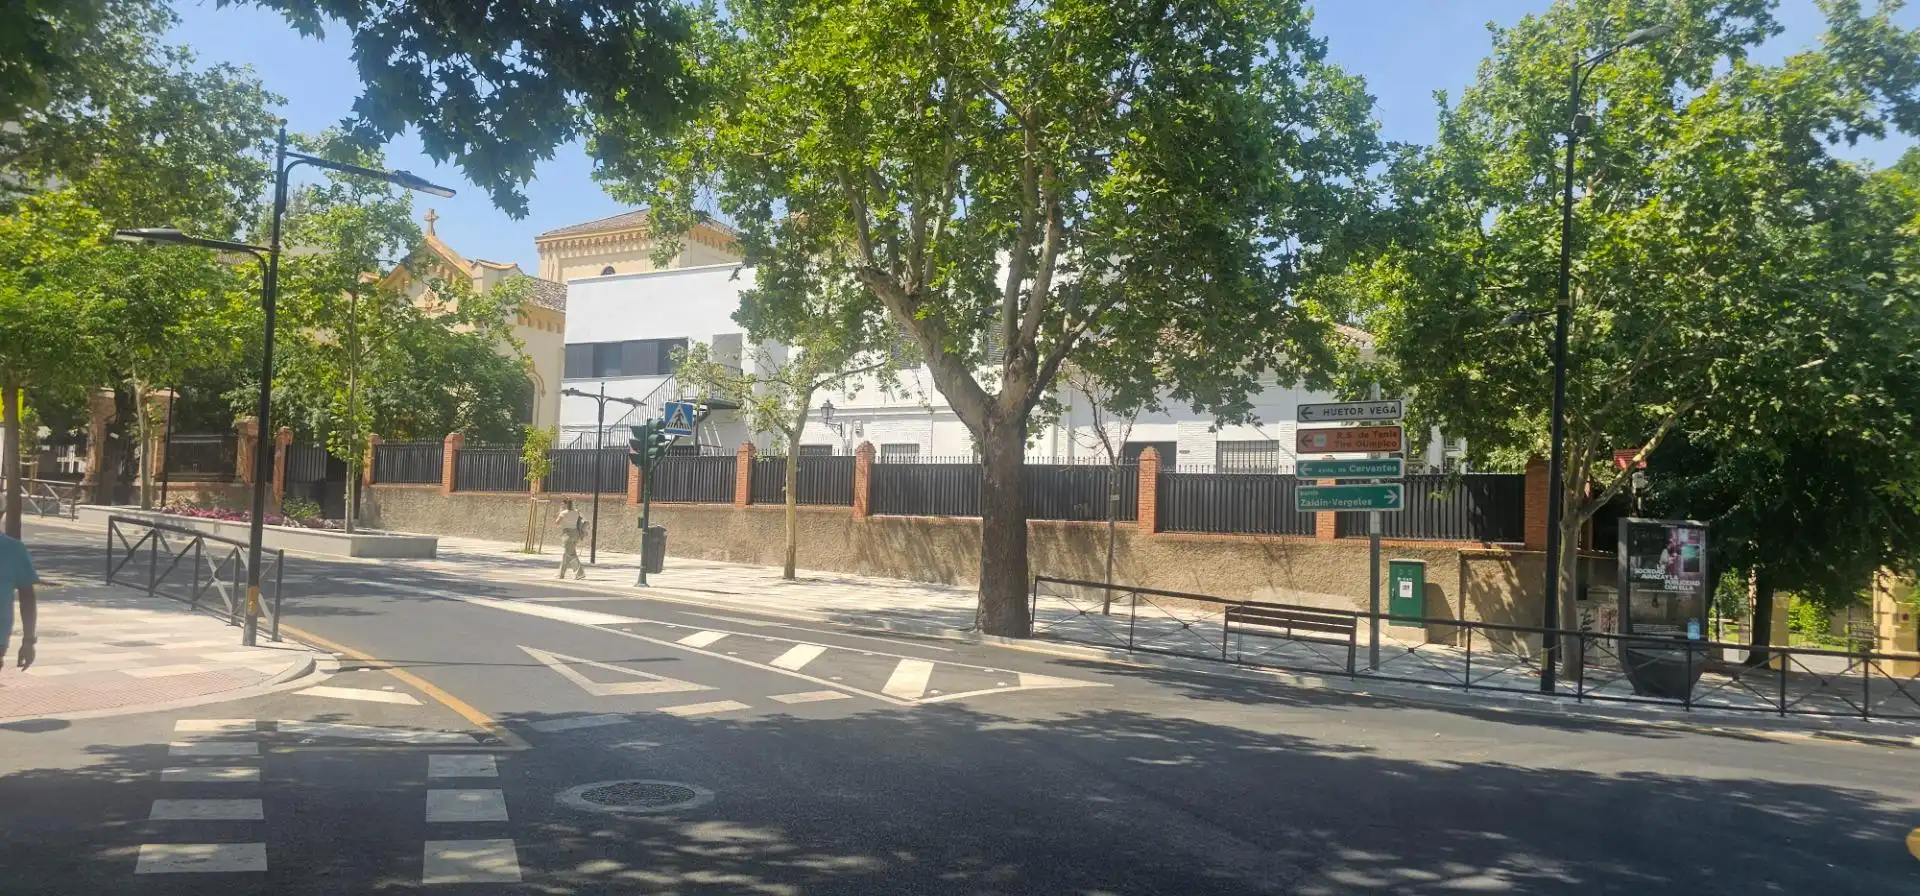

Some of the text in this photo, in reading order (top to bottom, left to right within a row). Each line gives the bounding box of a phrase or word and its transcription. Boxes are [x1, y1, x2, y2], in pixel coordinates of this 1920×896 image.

[1323, 406, 1397, 416] HUETOR VEGA
[1358, 430, 1369, 438] de
[1348, 464, 1397, 474] Cervantes
